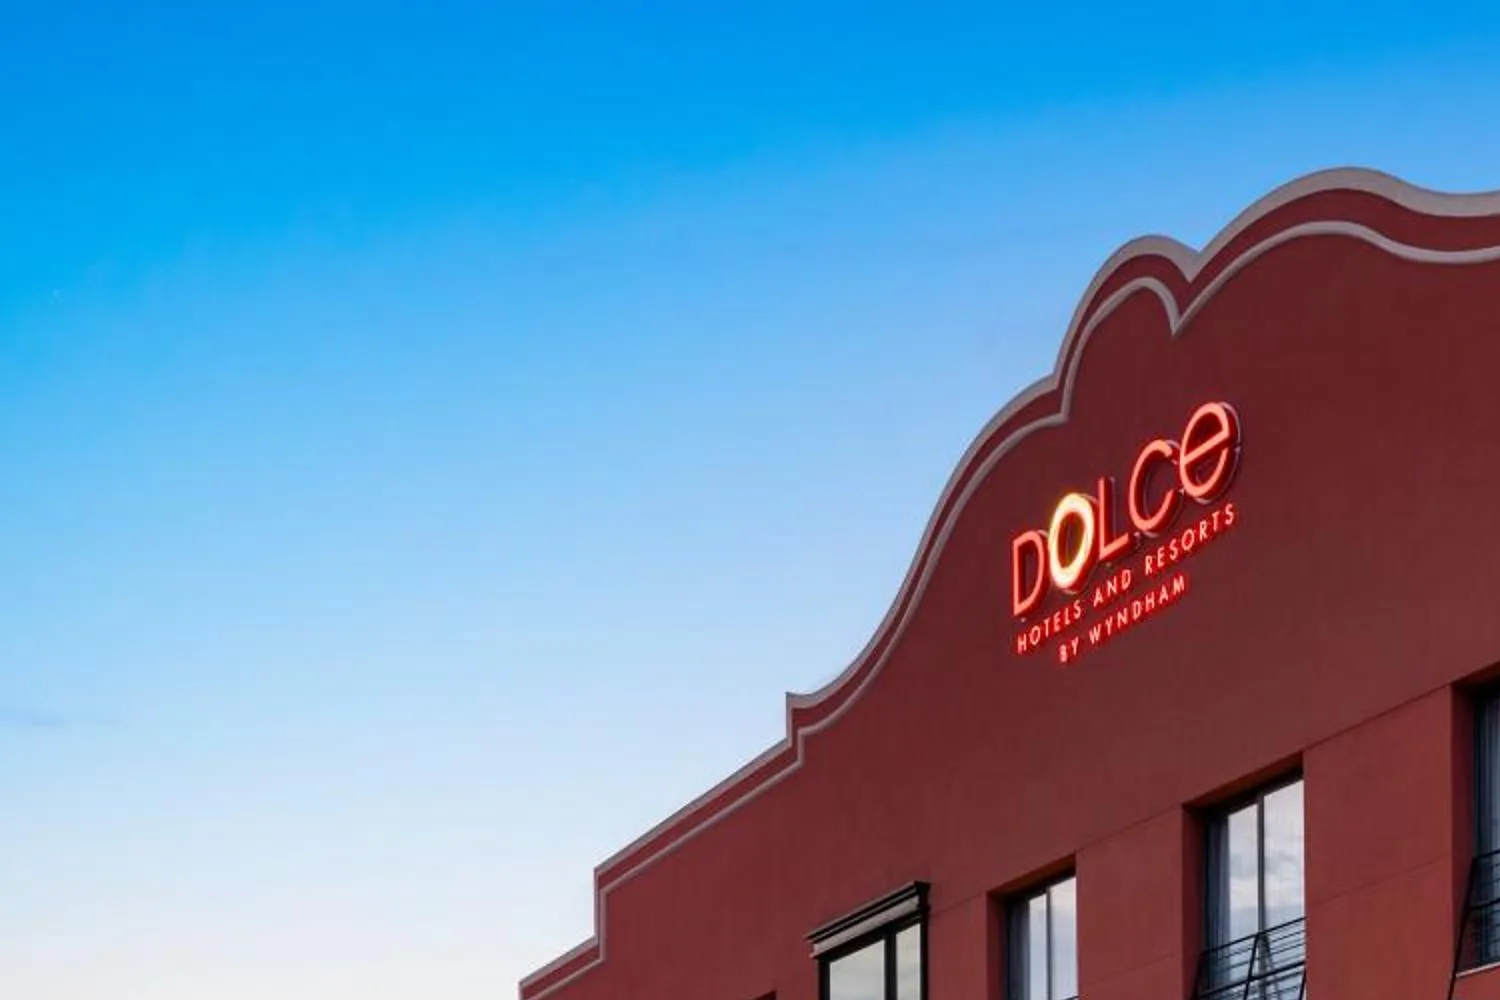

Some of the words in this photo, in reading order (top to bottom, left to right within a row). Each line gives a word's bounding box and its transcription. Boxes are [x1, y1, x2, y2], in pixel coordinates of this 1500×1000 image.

[1017, 599, 1082, 653] HOTELS
[1093, 569, 1132, 606] AND
[1144, 503, 1235, 576] RESORTS
[1058, 636, 1079, 662] BY
[1089, 575, 1186, 644] WYNDHAM
